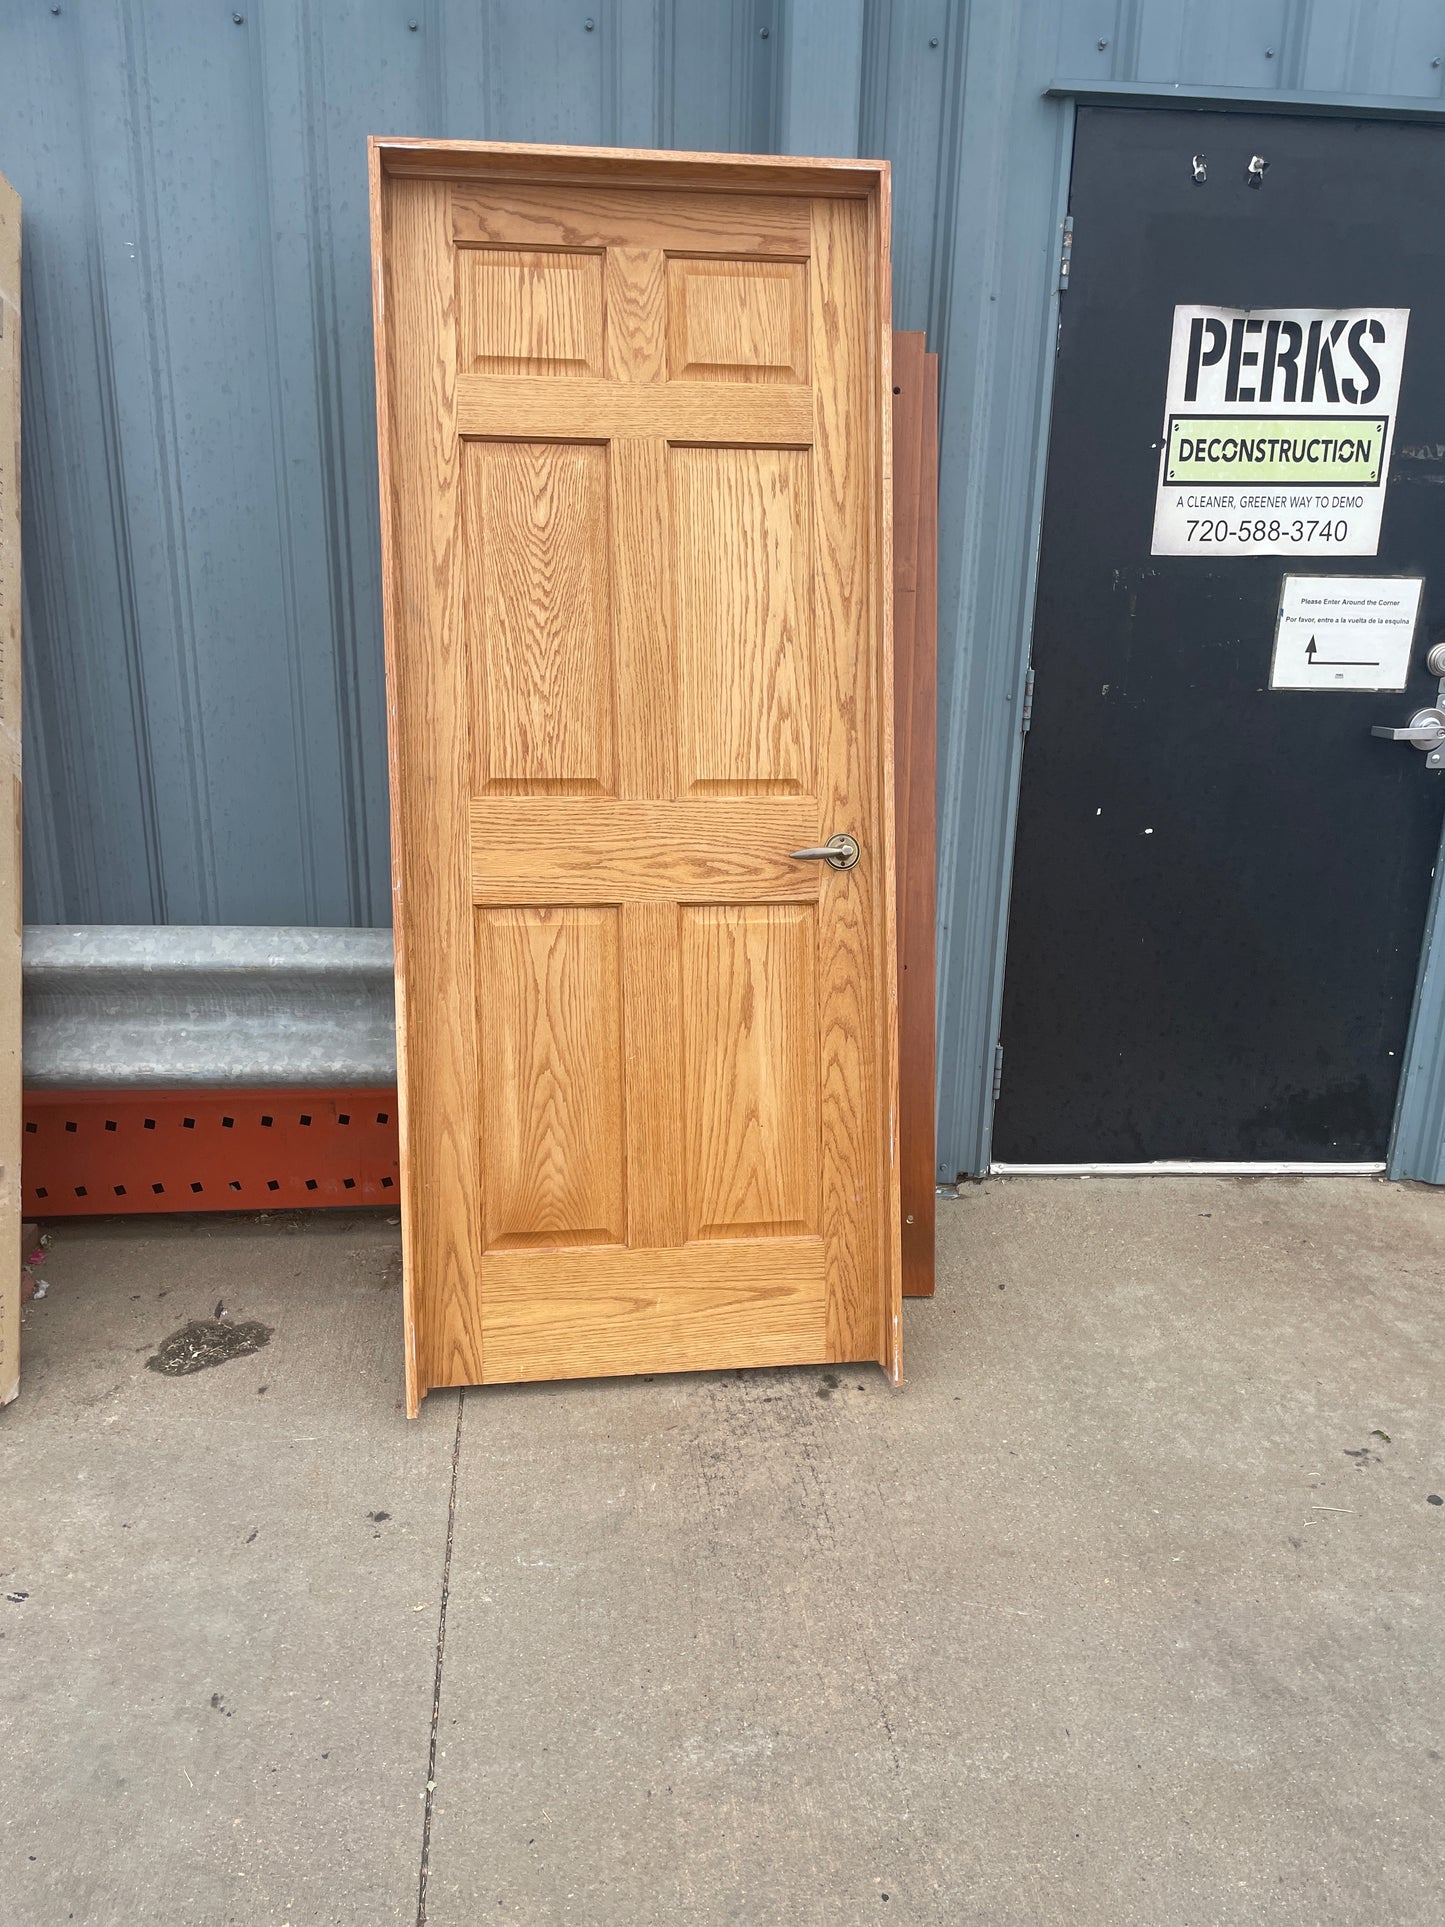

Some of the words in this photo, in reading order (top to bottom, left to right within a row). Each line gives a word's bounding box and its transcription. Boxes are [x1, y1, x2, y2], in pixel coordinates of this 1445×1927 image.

[1184, 318, 1386, 405] PERKS
[1179, 438, 1371, 463] DECONSTRUCTION
[1176, 496, 1184, 508] A
[1187, 495, 1236, 510] CLEANER,
[1239, 496, 1287, 508] GREENER
[1290, 496, 1312, 508] WAY
[1314, 496, 1329, 508] TO
[1332, 496, 1364, 508] DEMO
[1186, 519, 1348, 542] 720-588-3740
[1298, 616, 1316, 624] favor,
